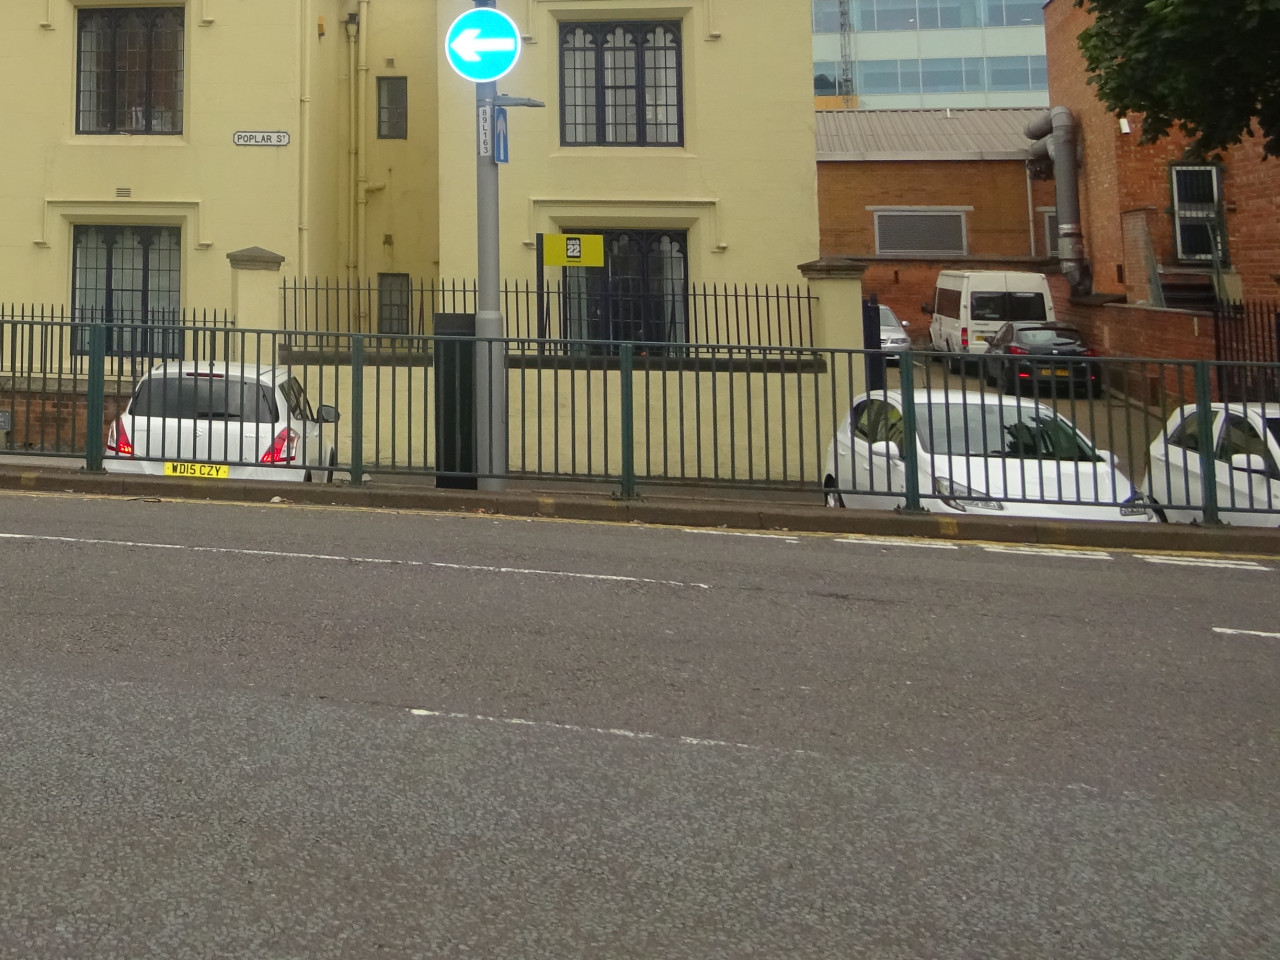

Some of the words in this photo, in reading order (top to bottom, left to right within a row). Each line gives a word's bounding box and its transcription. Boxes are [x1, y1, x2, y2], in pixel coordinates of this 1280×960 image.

[237, 134, 272, 143] POPLAR
[567, 244, 580, 256] 22
[172, 463, 196, 475] WD15
[199, 465, 222, 477] CZY
